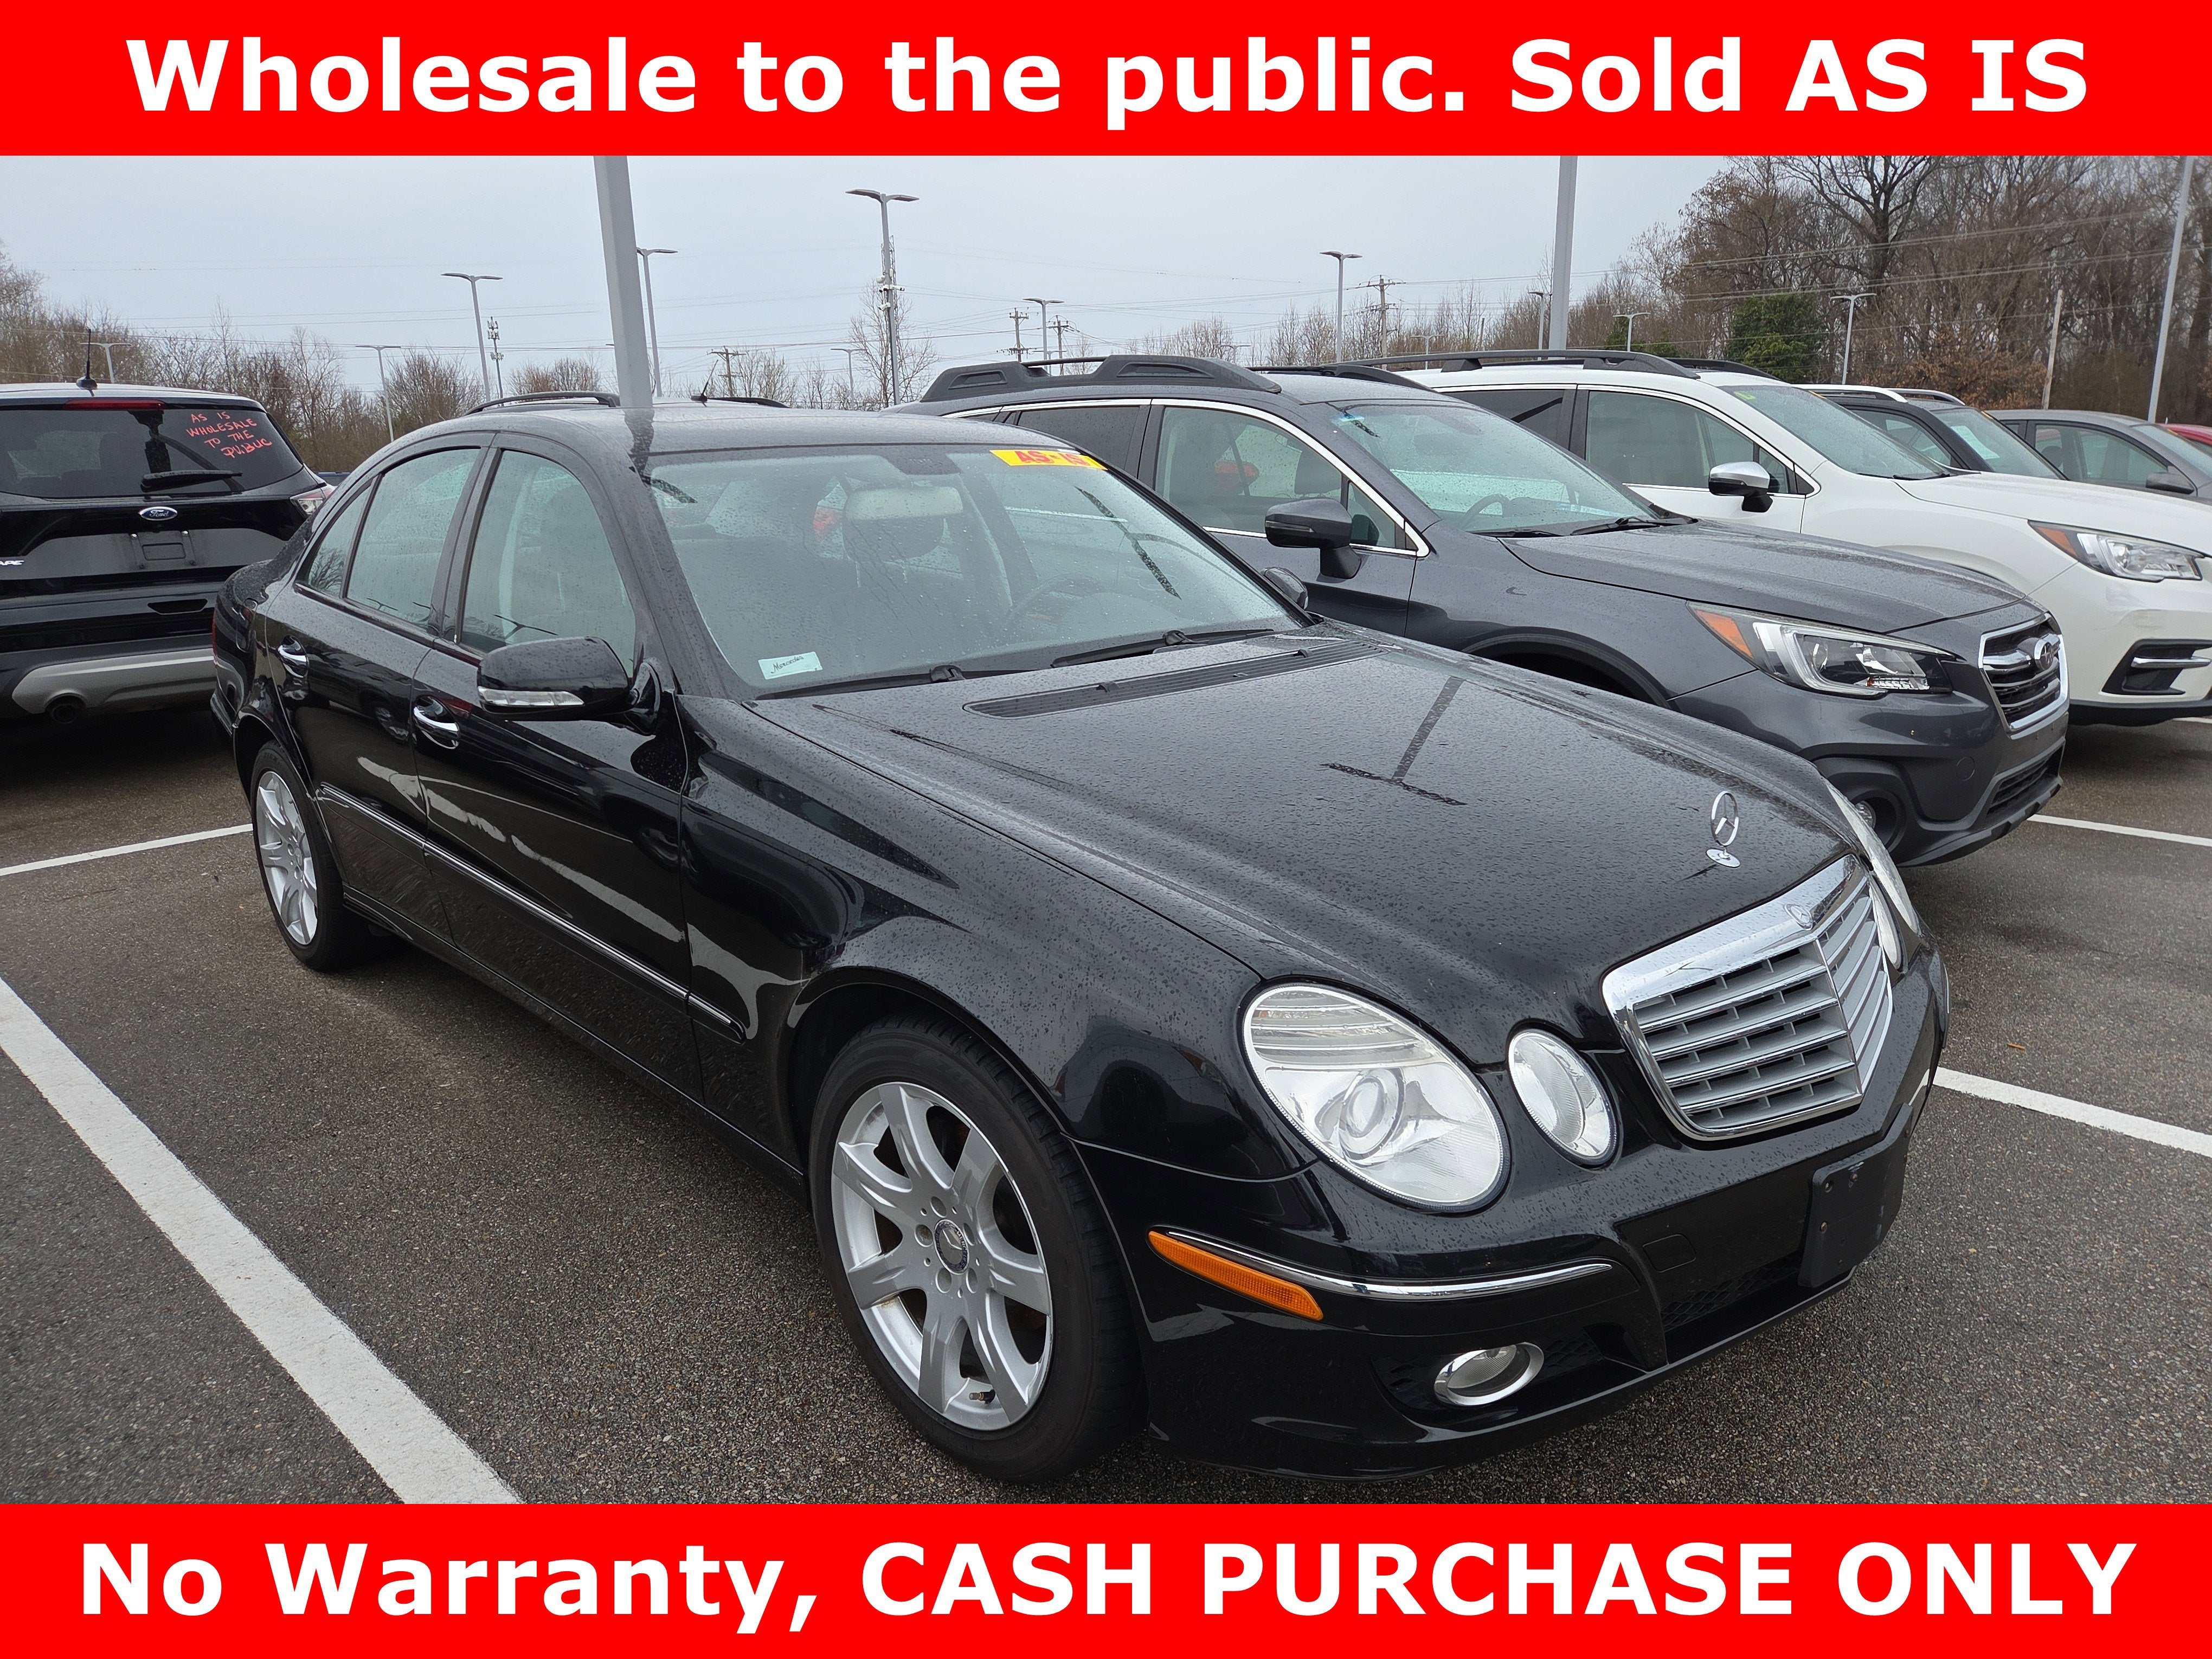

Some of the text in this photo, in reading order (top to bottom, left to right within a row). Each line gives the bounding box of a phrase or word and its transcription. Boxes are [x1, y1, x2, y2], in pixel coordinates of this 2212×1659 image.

[191, 411, 230, 423] AS IS
[186, 418, 257, 437] WHOLESALE
[204, 429, 254, 448] TO THE
[770, 655, 805, 674] Mercedes
